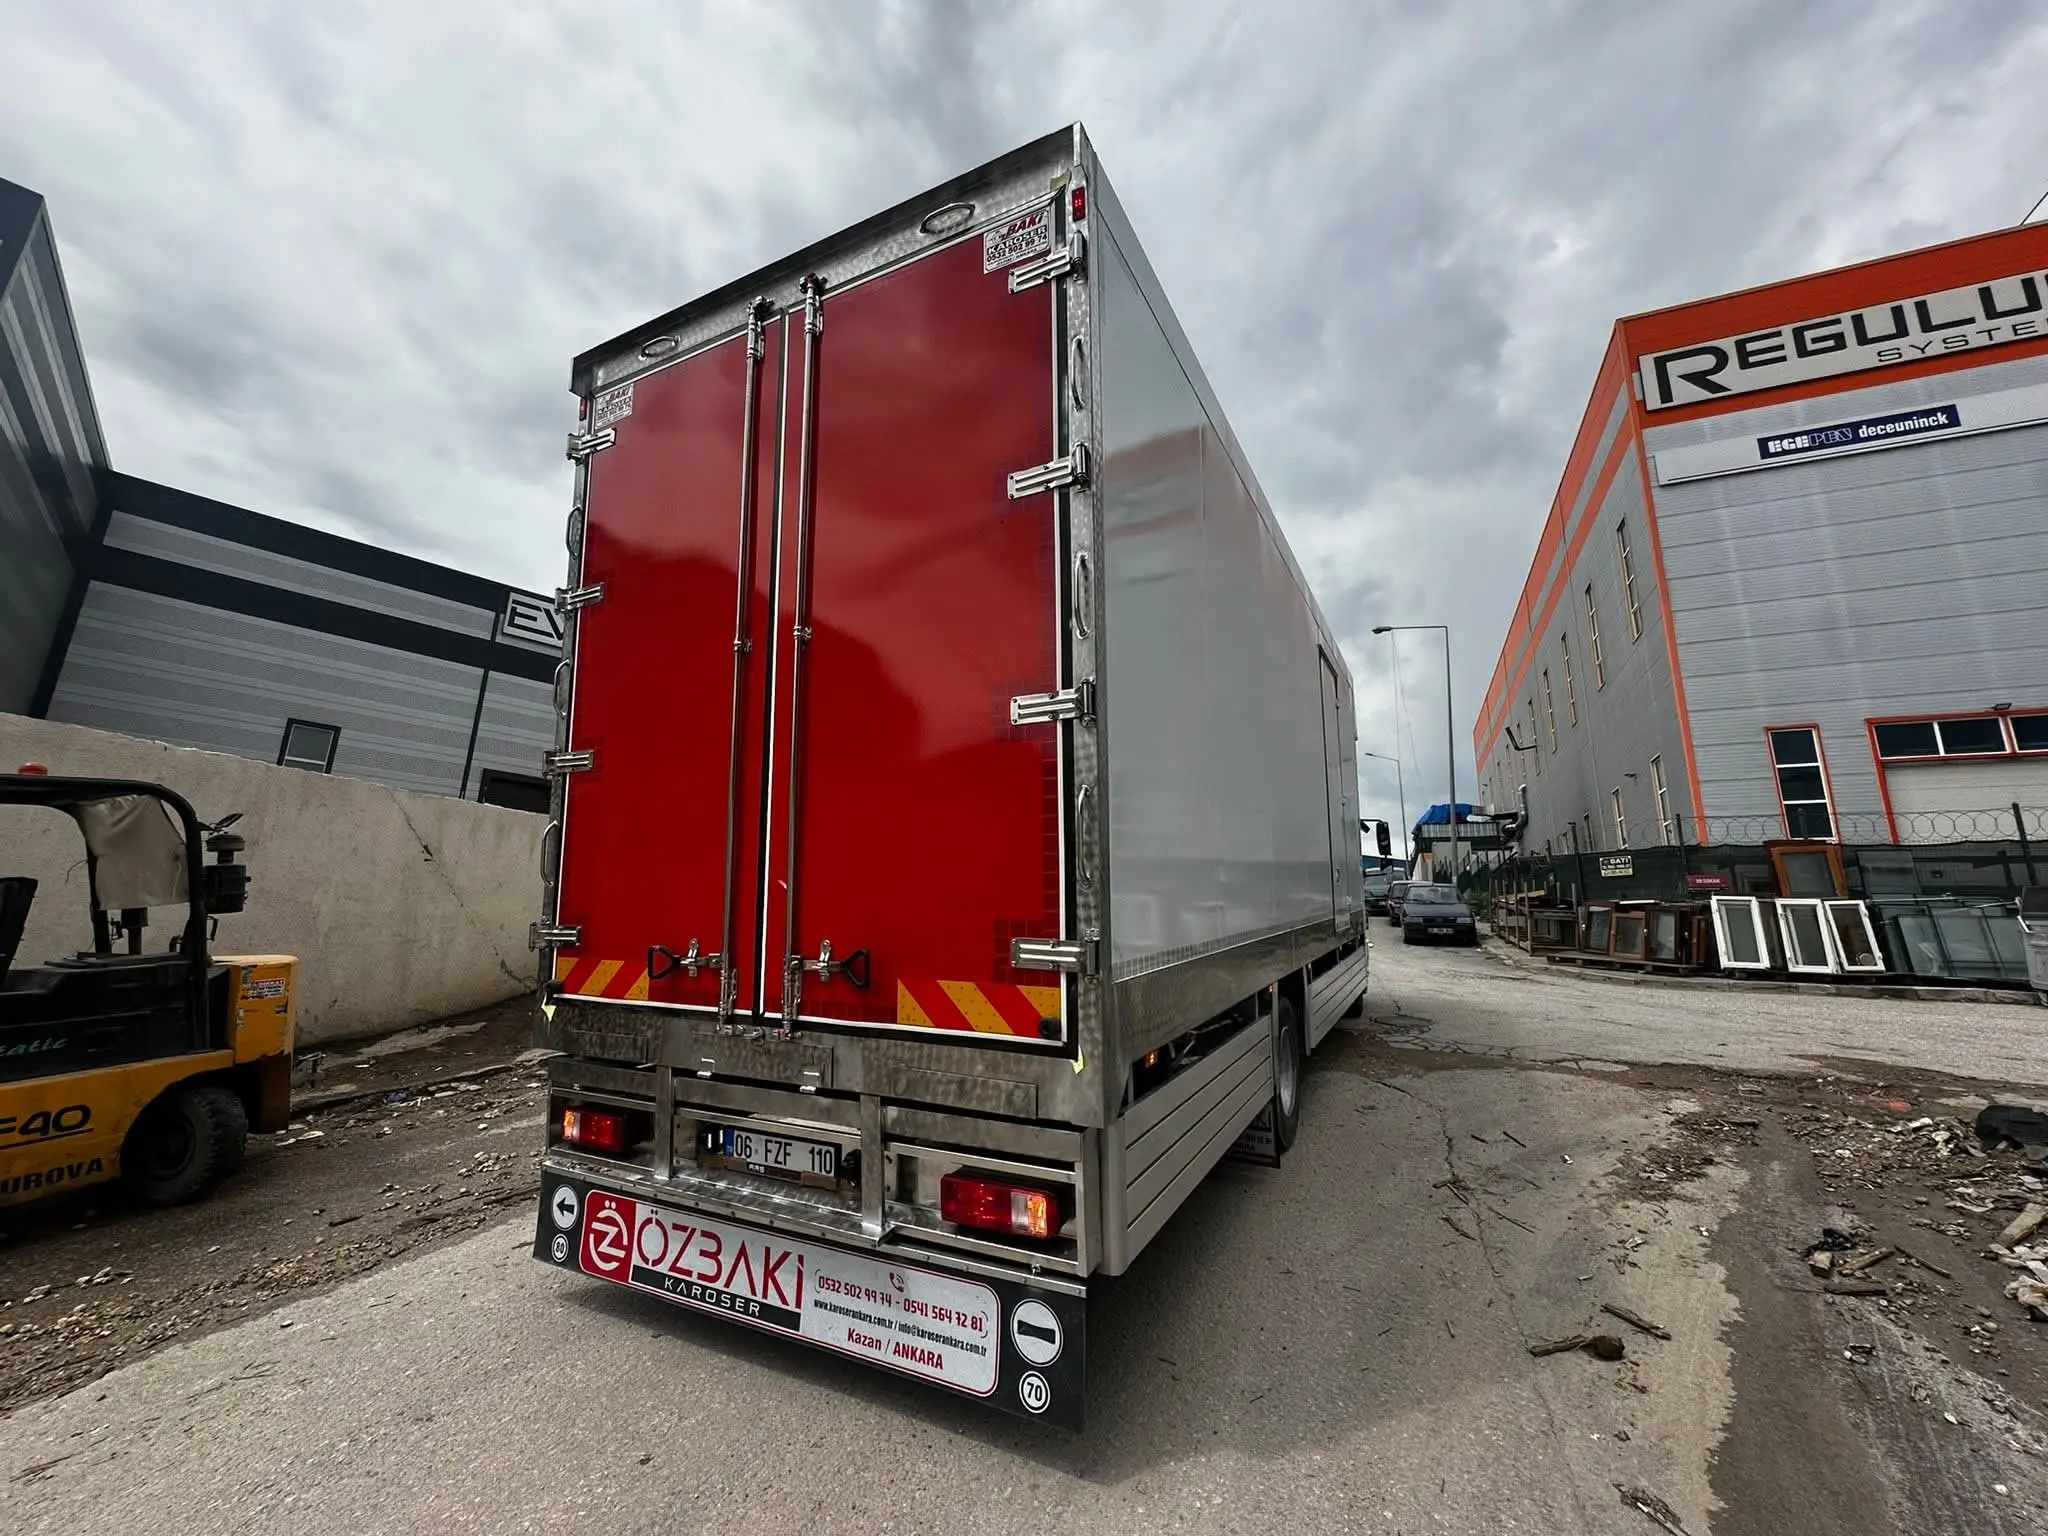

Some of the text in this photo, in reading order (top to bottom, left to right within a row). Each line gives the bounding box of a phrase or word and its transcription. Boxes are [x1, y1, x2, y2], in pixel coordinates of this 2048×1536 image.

[988, 225, 1047, 255] KAROSER
[1009, 244, 1023, 254] 502
[1038, 233, 1047, 243] 74
[1654, 273, 2048, 404] REGULU
[1877, 316, 2048, 363] SYSTE
[1858, 411, 1950, 439] deceuninck
[735, 1133, 833, 1175] 06 FZF 110
[664, 1276, 760, 1317] KAROSER
[818, 1275, 841, 1294] 0532
[844, 1283, 861, 1300] 502
[864, 1287, 877, 1304] 99
[879, 1291, 892, 1307] 74
[903, 1298, 929, 1317] 0541
[932, 1306, 952, 1324] 564
[955, 1311, 968, 1328] 72
[970, 1316, 983, 1333] 81
[813, 1299, 894, 1330] www.karoserankara.com.tr
[898, 1323, 988, 1357] info@karoserankara.com.tr
[847, 1327, 882, 1352] Kazan
[893, 1341, 944, 1370] ANKARA
[1026, 1381, 1043, 1402] 70
